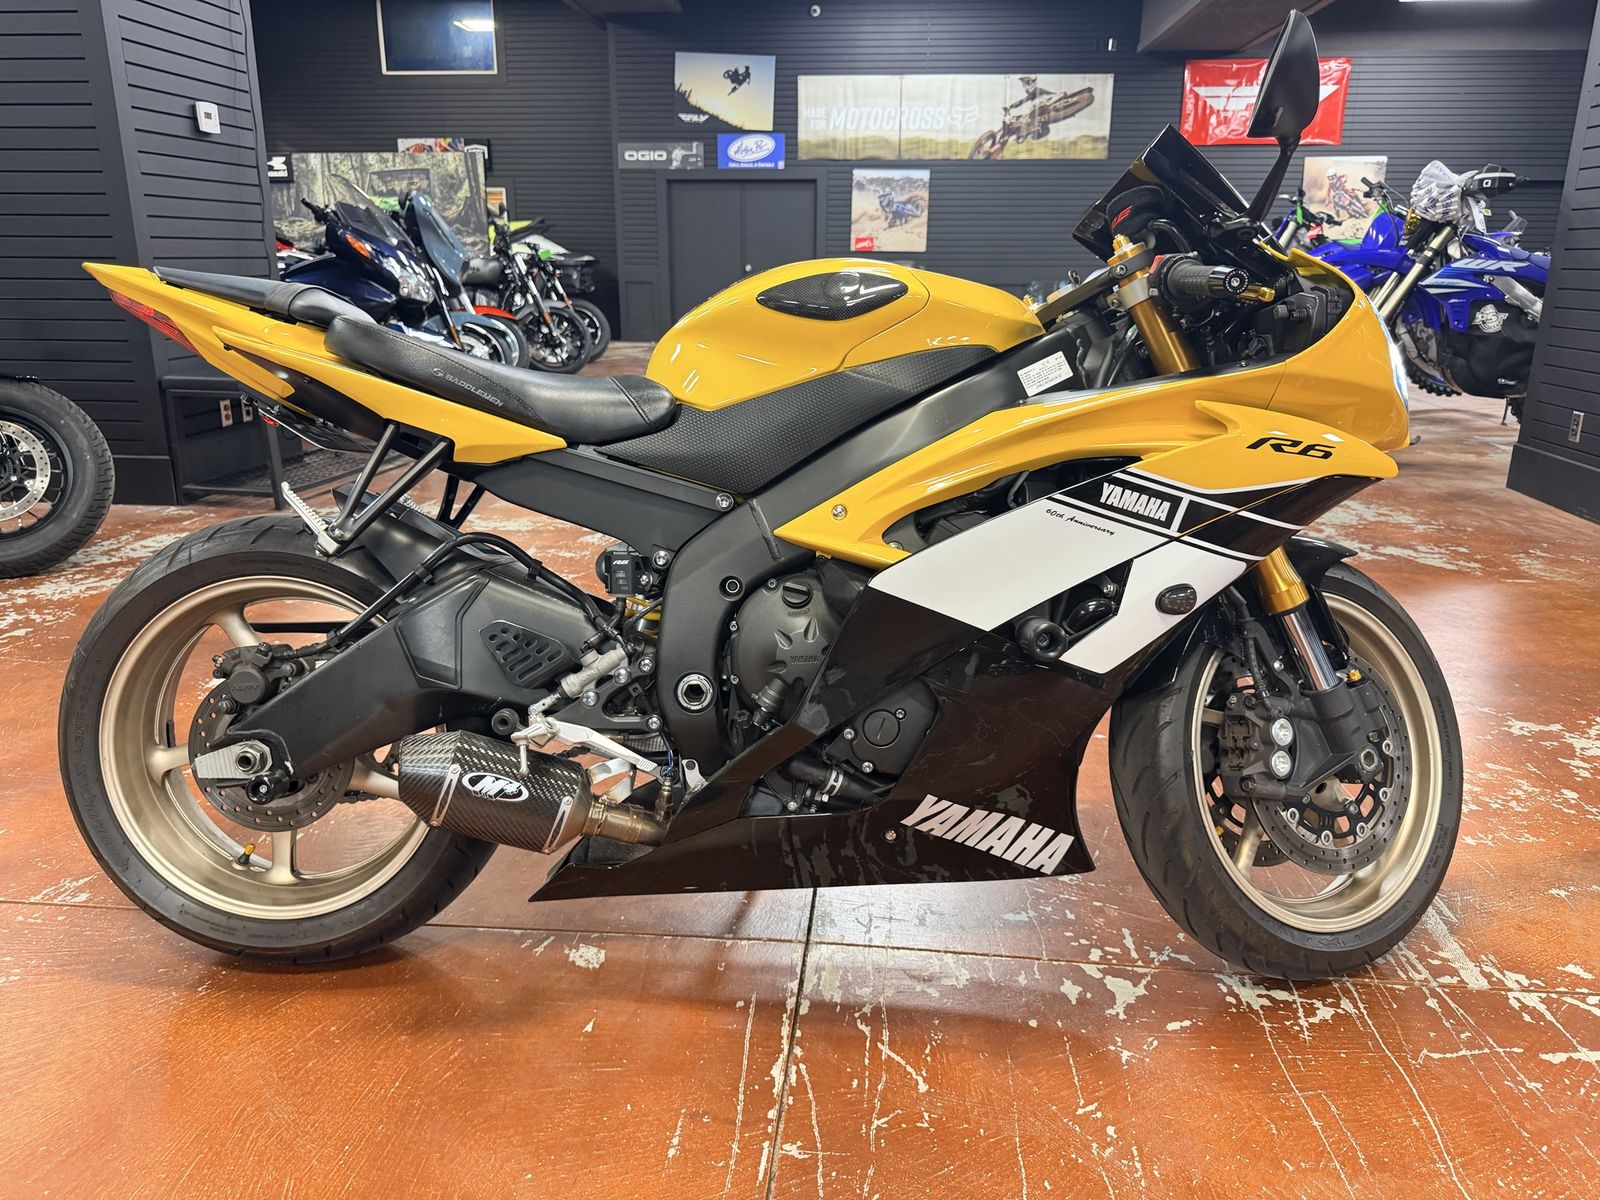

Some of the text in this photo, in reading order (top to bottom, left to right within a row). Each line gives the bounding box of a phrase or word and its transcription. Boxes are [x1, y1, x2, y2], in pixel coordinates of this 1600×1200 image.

[829, 106, 945, 130] MOTOCROSS
[624, 150, 667, 161] OGIO
[1450, 258, 1529, 272] WR
[445, 374, 504, 408] SADDLEMEN
[1246, 436, 1336, 460] R6
[1099, 482, 1171, 522] YAMAHA
[1045, 507, 1115, 536] 60th Anniversary
[900, 793, 1075, 875] YAMAHA
